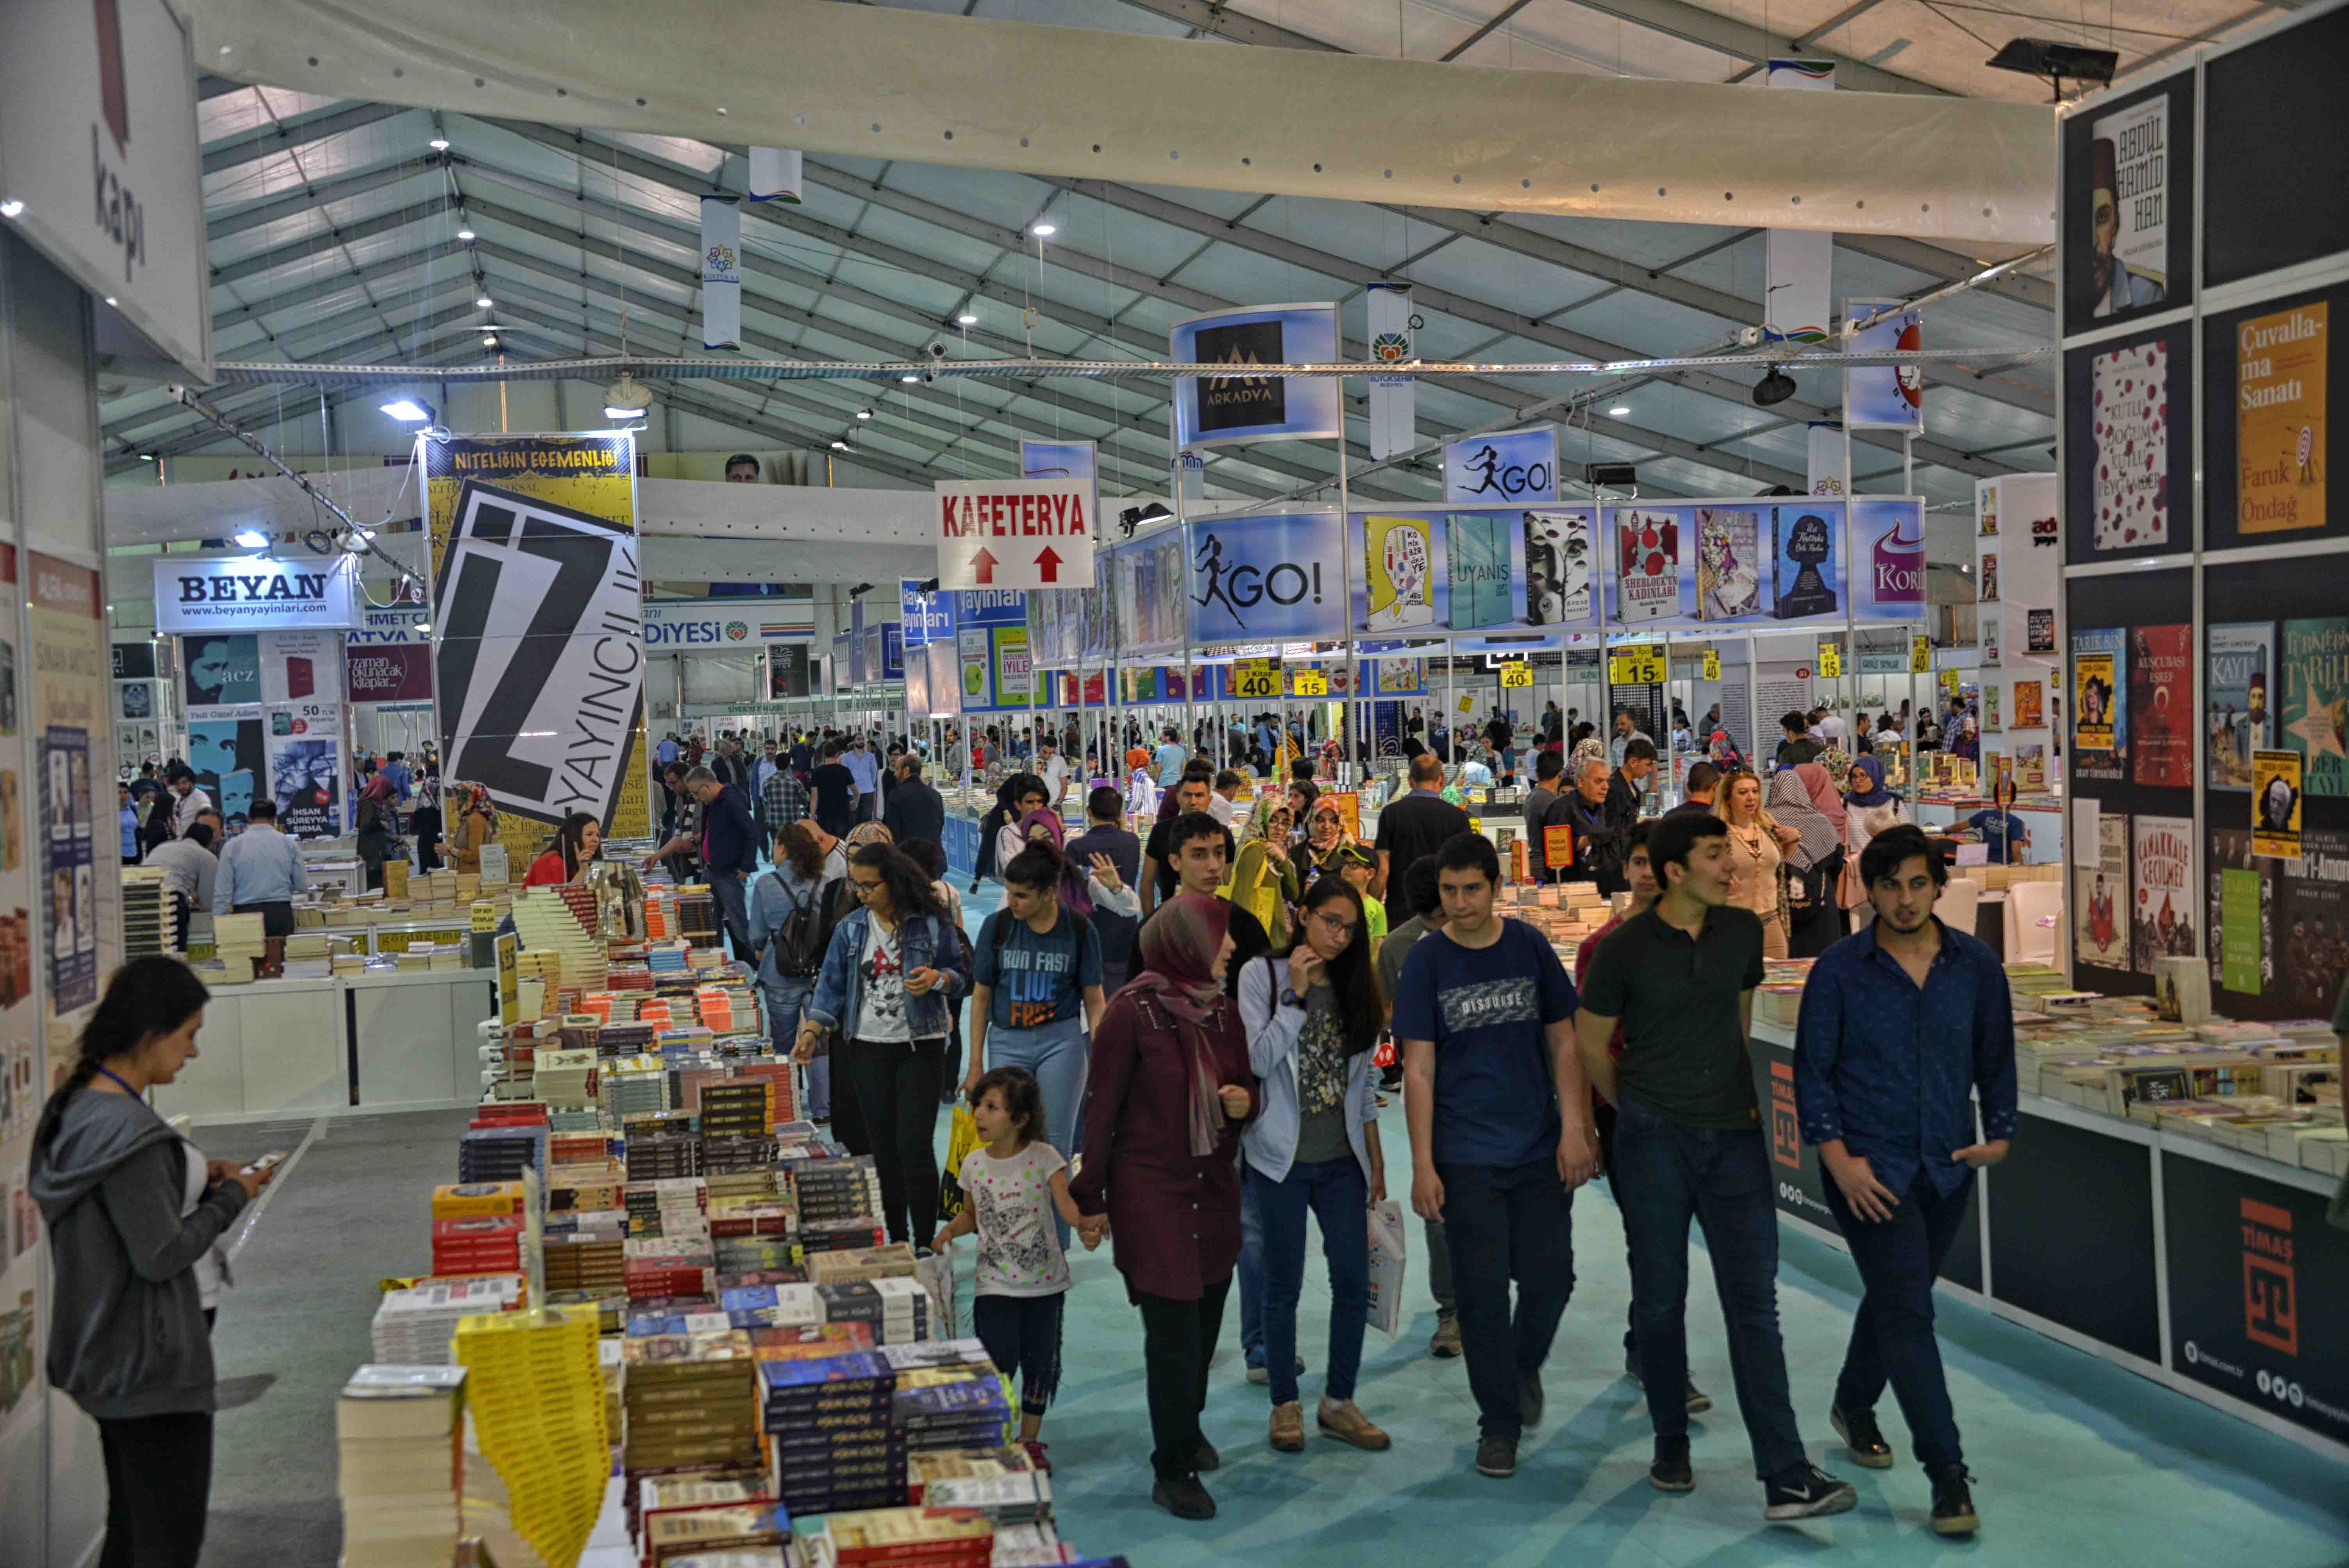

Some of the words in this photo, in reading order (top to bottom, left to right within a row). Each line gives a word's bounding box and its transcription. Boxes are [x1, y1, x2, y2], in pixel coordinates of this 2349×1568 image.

[2119, 116, 2163, 164] ABDÜL
[2134, 192, 2163, 232] HAN
[2242, 313, 2324, 357] Çuvalla-
[2241, 356, 2272, 381] ma
[1206, 388, 1272, 407] ARKADYA
[2241, 379, 2302, 410] Sanatı
[1502, 462, 1552, 494] GO!
[2241, 461, 2288, 489] Faruk
[942, 494, 1085, 537] KAFETERYA
[2241, 493, 2297, 524] Öndağ
[1409, 547, 1422, 556] BİR
[1228, 562, 1321, 608] GO!
[1457, 564, 1509, 582] UYANIŞ
[1624, 576, 1678, 588] SHERLOCK'UN
[178, 574, 327, 602] BEYAN
[903, 588, 937, 611] Hayt
[1628, 586, 1676, 600] KADINLARI
[181, 603, 327, 617] www.beyanyayinlari.com
[2072, 636, 2100, 651] TARIK
[2105, 631, 2121, 650] BİN
[352, 665, 403, 678] okunacak
[353, 657, 389, 668] zaman
[2211, 655, 2248, 685] KAYI
[221, 670, 255, 683] acz
[2149, 672, 2174, 683] EŞREF
[210, 710, 233, 719] Güzel
[235, 709, 259, 718] Adam
[303, 705, 319, 716] 50
[728, 704, 747, 713] SİYER
[286, 815, 328, 825] SÜREYYA
[292, 806, 321, 815] İHSAN
[2137, 832, 2189, 867] ÇANAKKALE
[2142, 860, 2184, 887] GEÇİLMEZ
[1003, 949, 1030, 969] RUN
[1035, 950, 1069, 973] FAST
[1010, 972, 1057, 1001] LIVE
[1010, 1001, 1057, 1027] FAST
[2241, 1222, 2293, 1262] TİMAŞ
